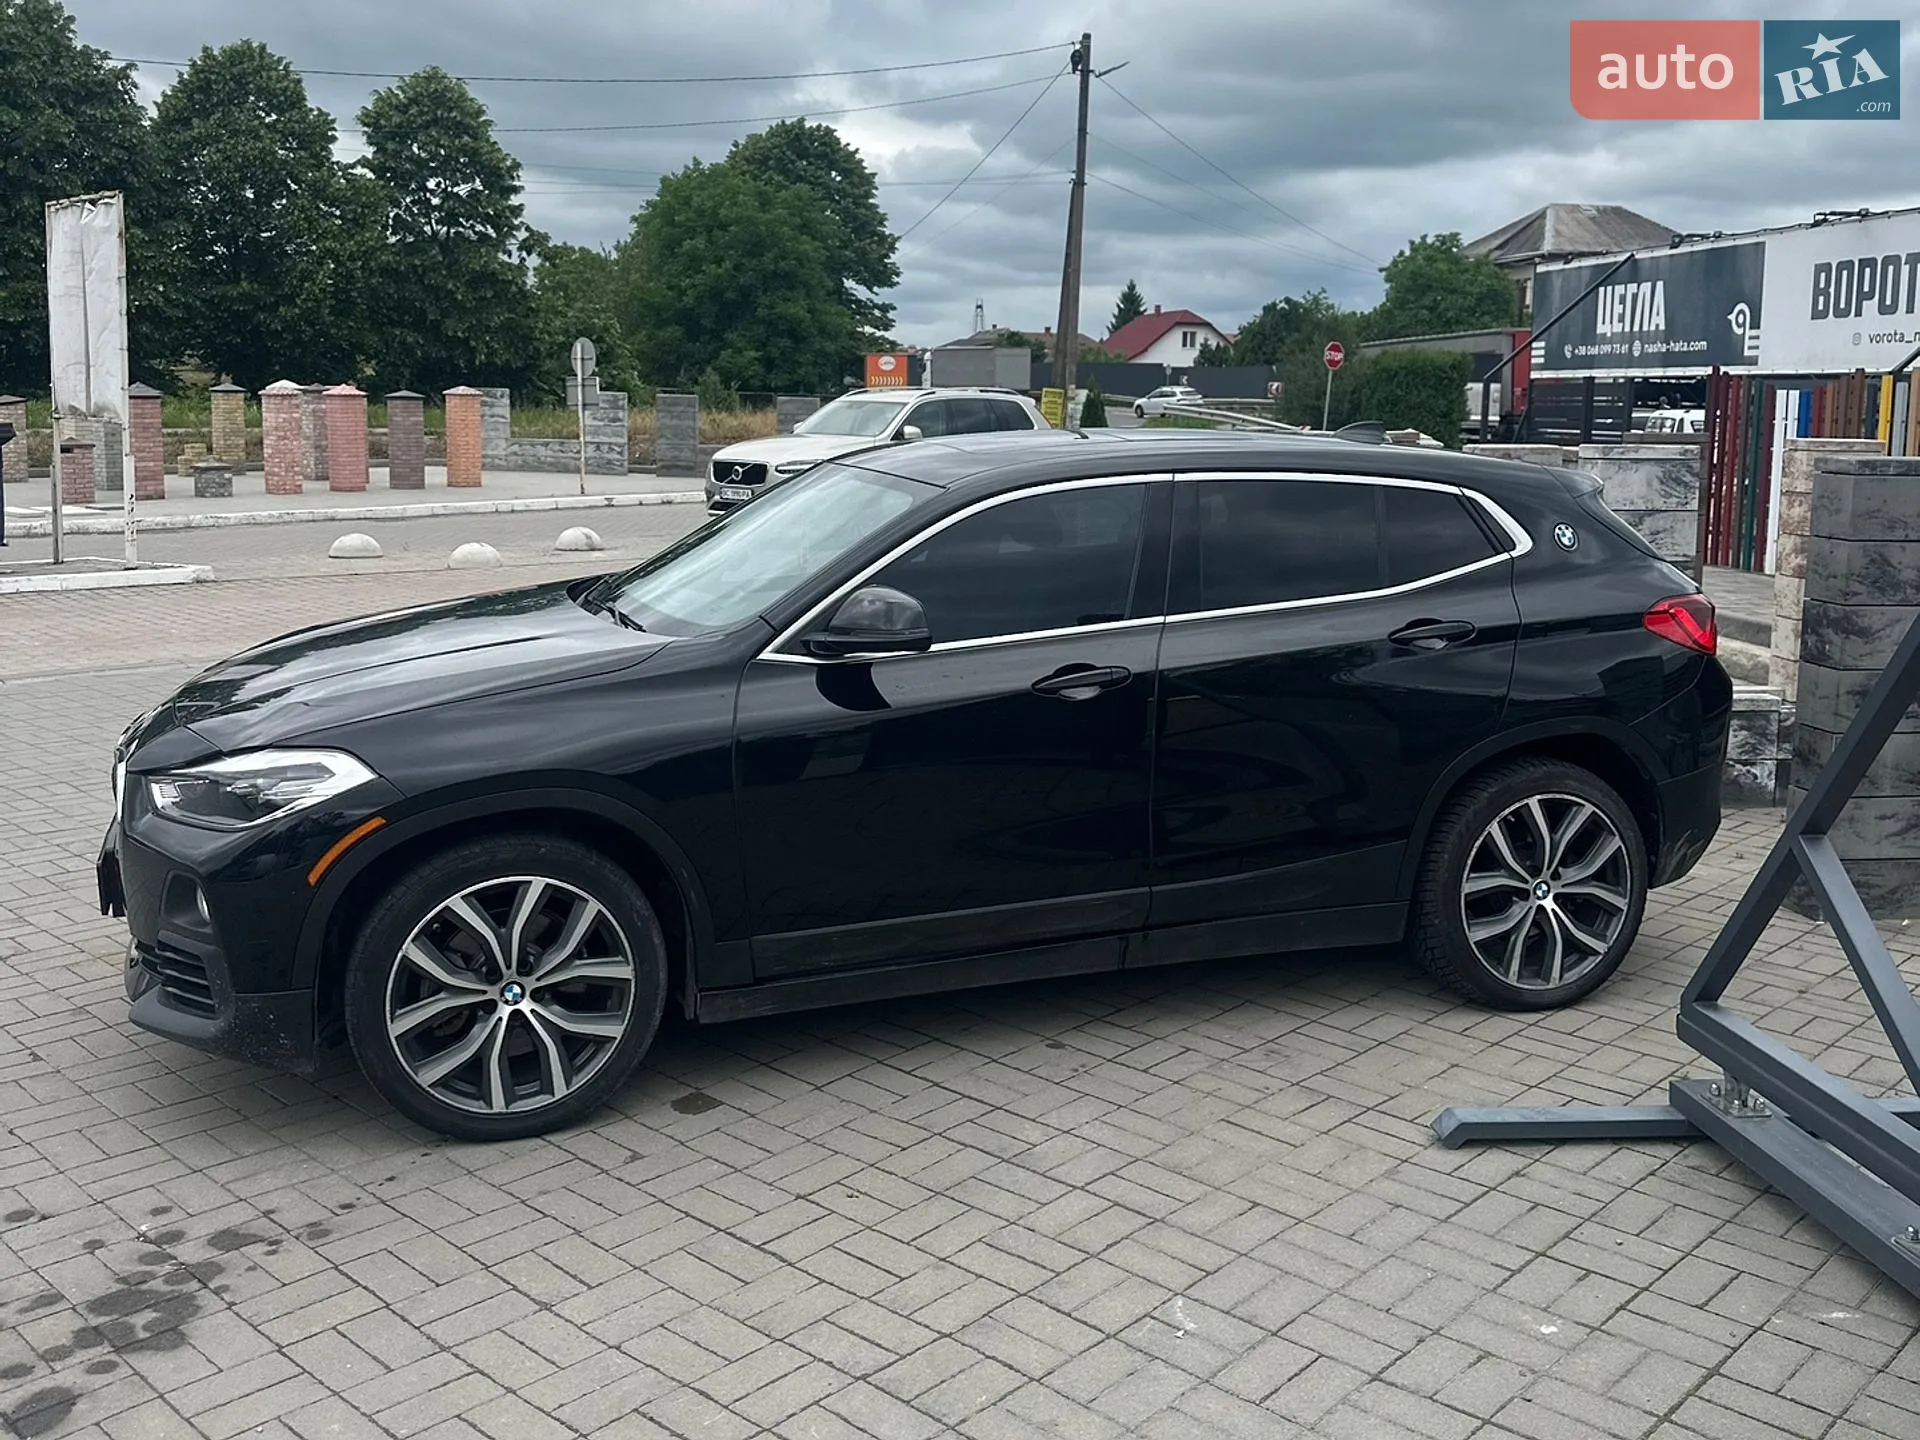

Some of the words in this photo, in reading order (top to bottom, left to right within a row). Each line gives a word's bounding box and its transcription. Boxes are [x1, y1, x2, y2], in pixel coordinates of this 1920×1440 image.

[1810, 251, 1920, 320] ВОРОТ
[1596, 280, 1666, 337] ЦЕГЛА
[1326, 350, 1344, 361] STOP
[1644, 340, 1708, 353] nasha-hata.com
